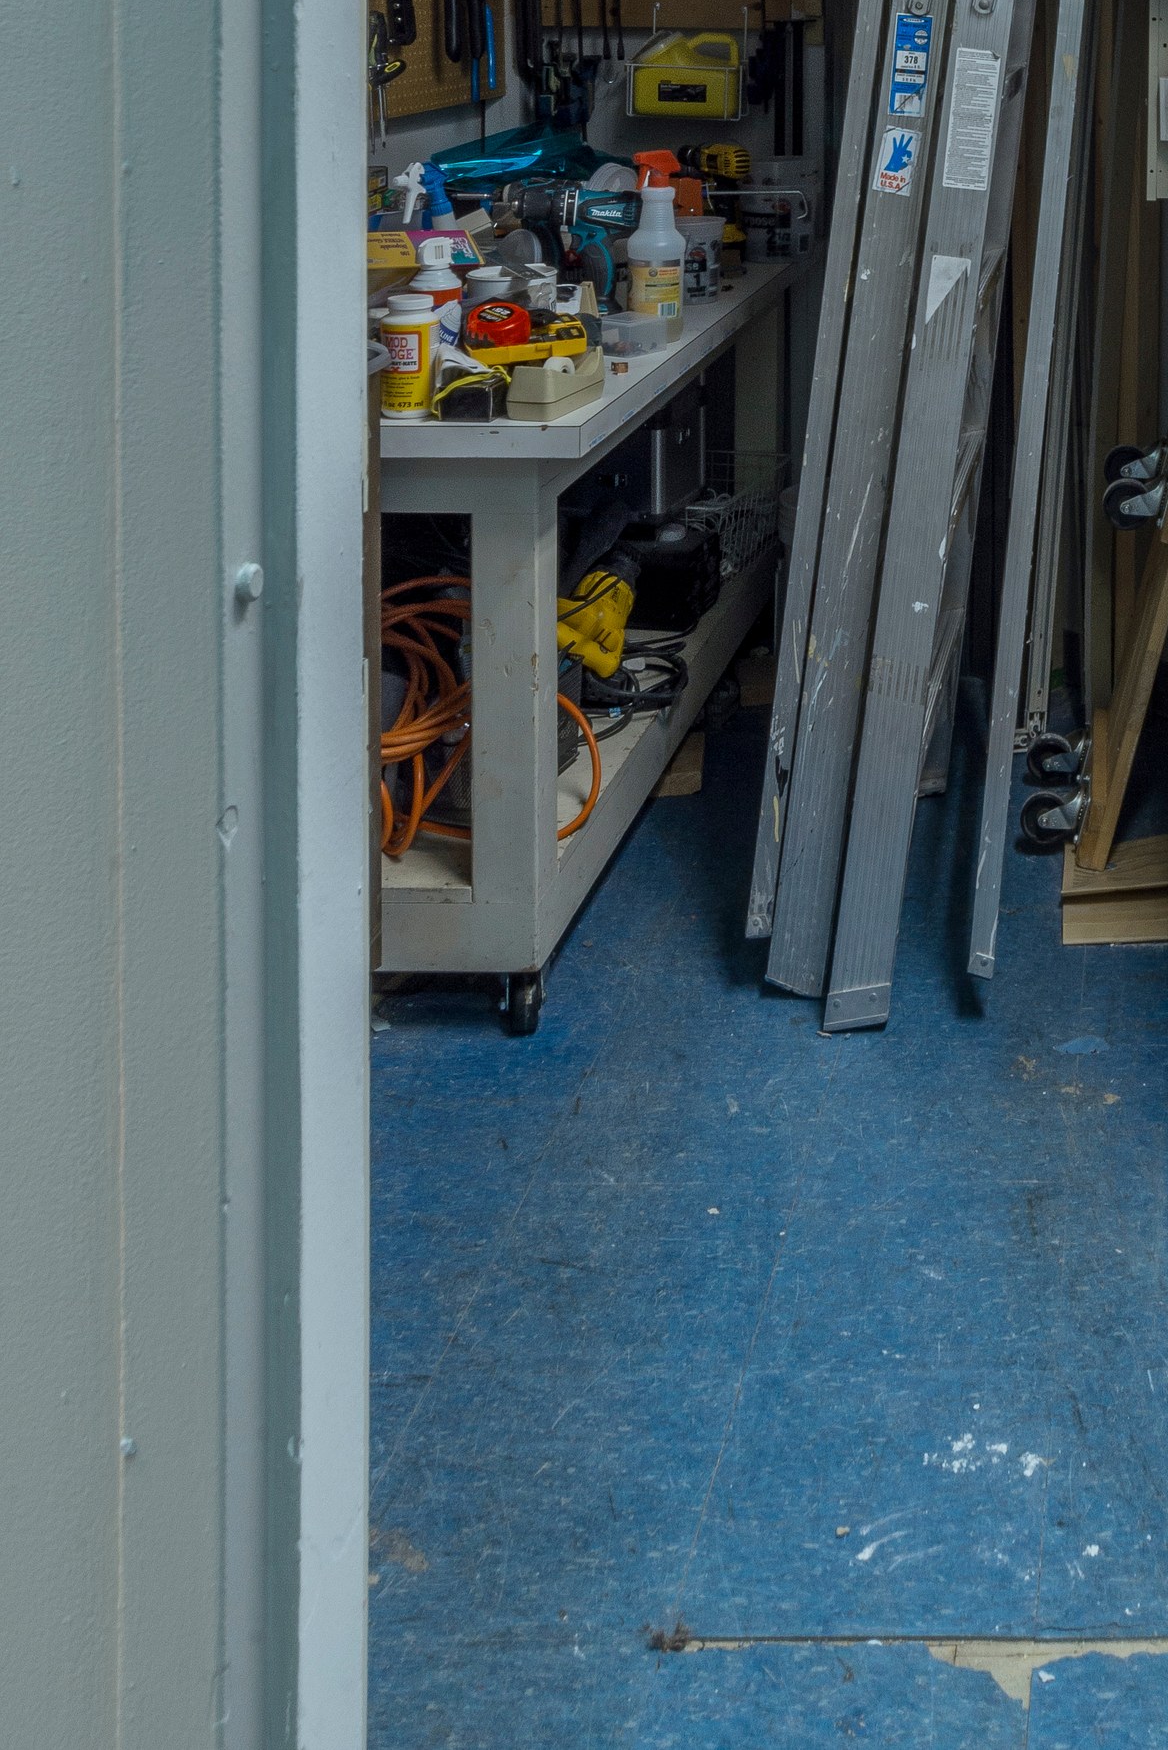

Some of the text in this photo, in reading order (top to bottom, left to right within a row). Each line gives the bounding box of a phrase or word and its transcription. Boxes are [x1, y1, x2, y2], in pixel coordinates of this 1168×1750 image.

[904, 55, 918, 64] 378
[880, 171, 906, 183] Made in
